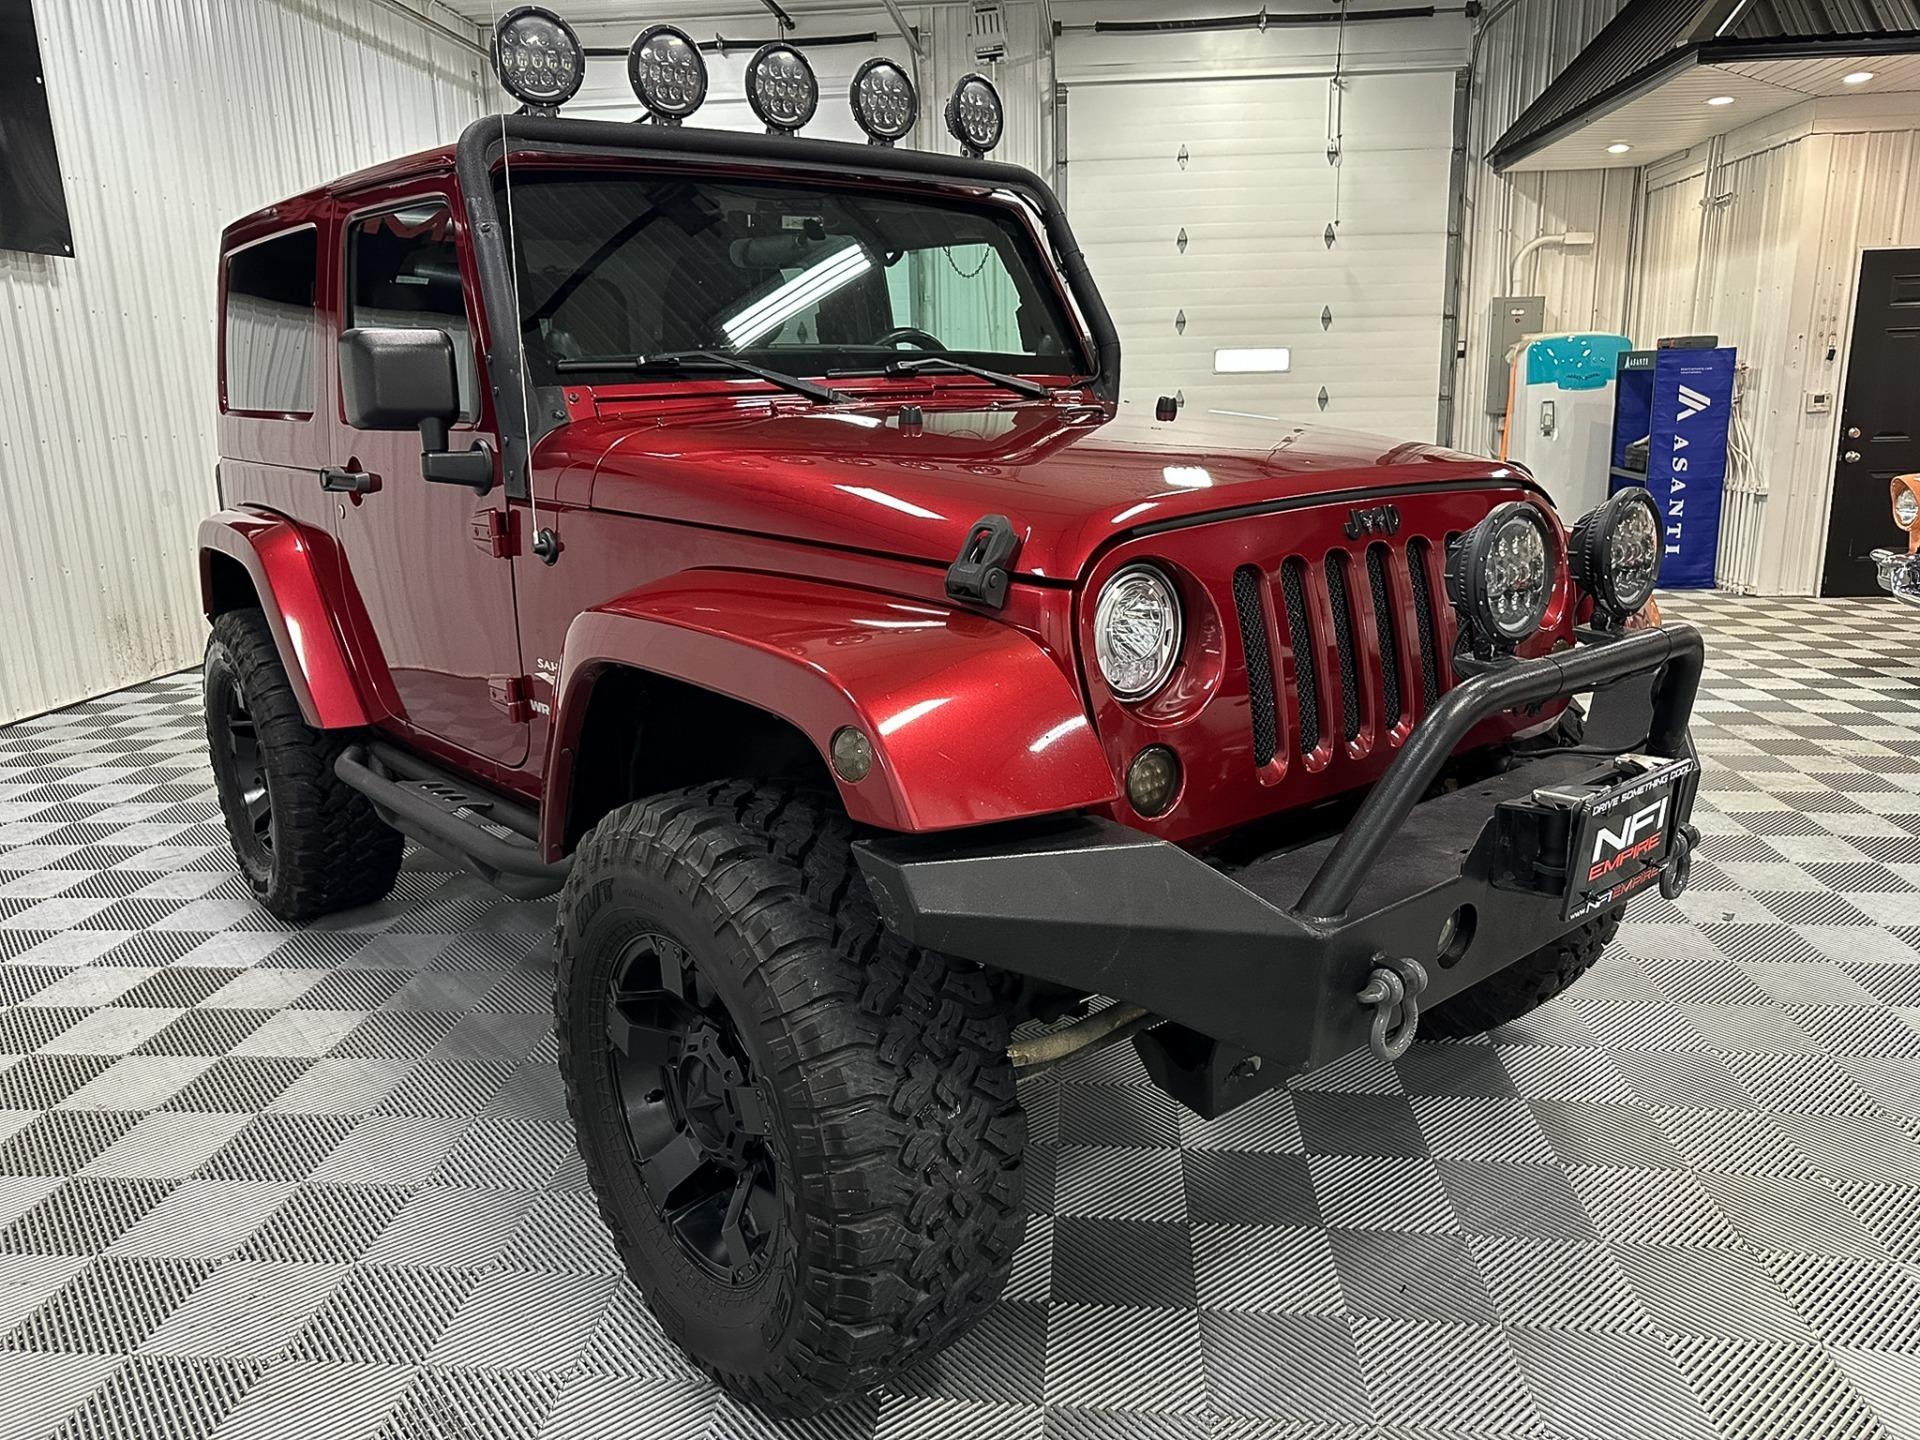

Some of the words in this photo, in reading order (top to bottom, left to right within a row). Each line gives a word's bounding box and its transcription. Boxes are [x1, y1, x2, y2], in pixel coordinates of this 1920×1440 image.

[1665, 434, 1689, 555] ASANTI
[1592, 796, 1620, 816] DRIVE
[1621, 775, 1669, 802] SOMETHING
[1588, 832, 1662, 881] EMPIRE
[1592, 796, 1669, 864] NFI
